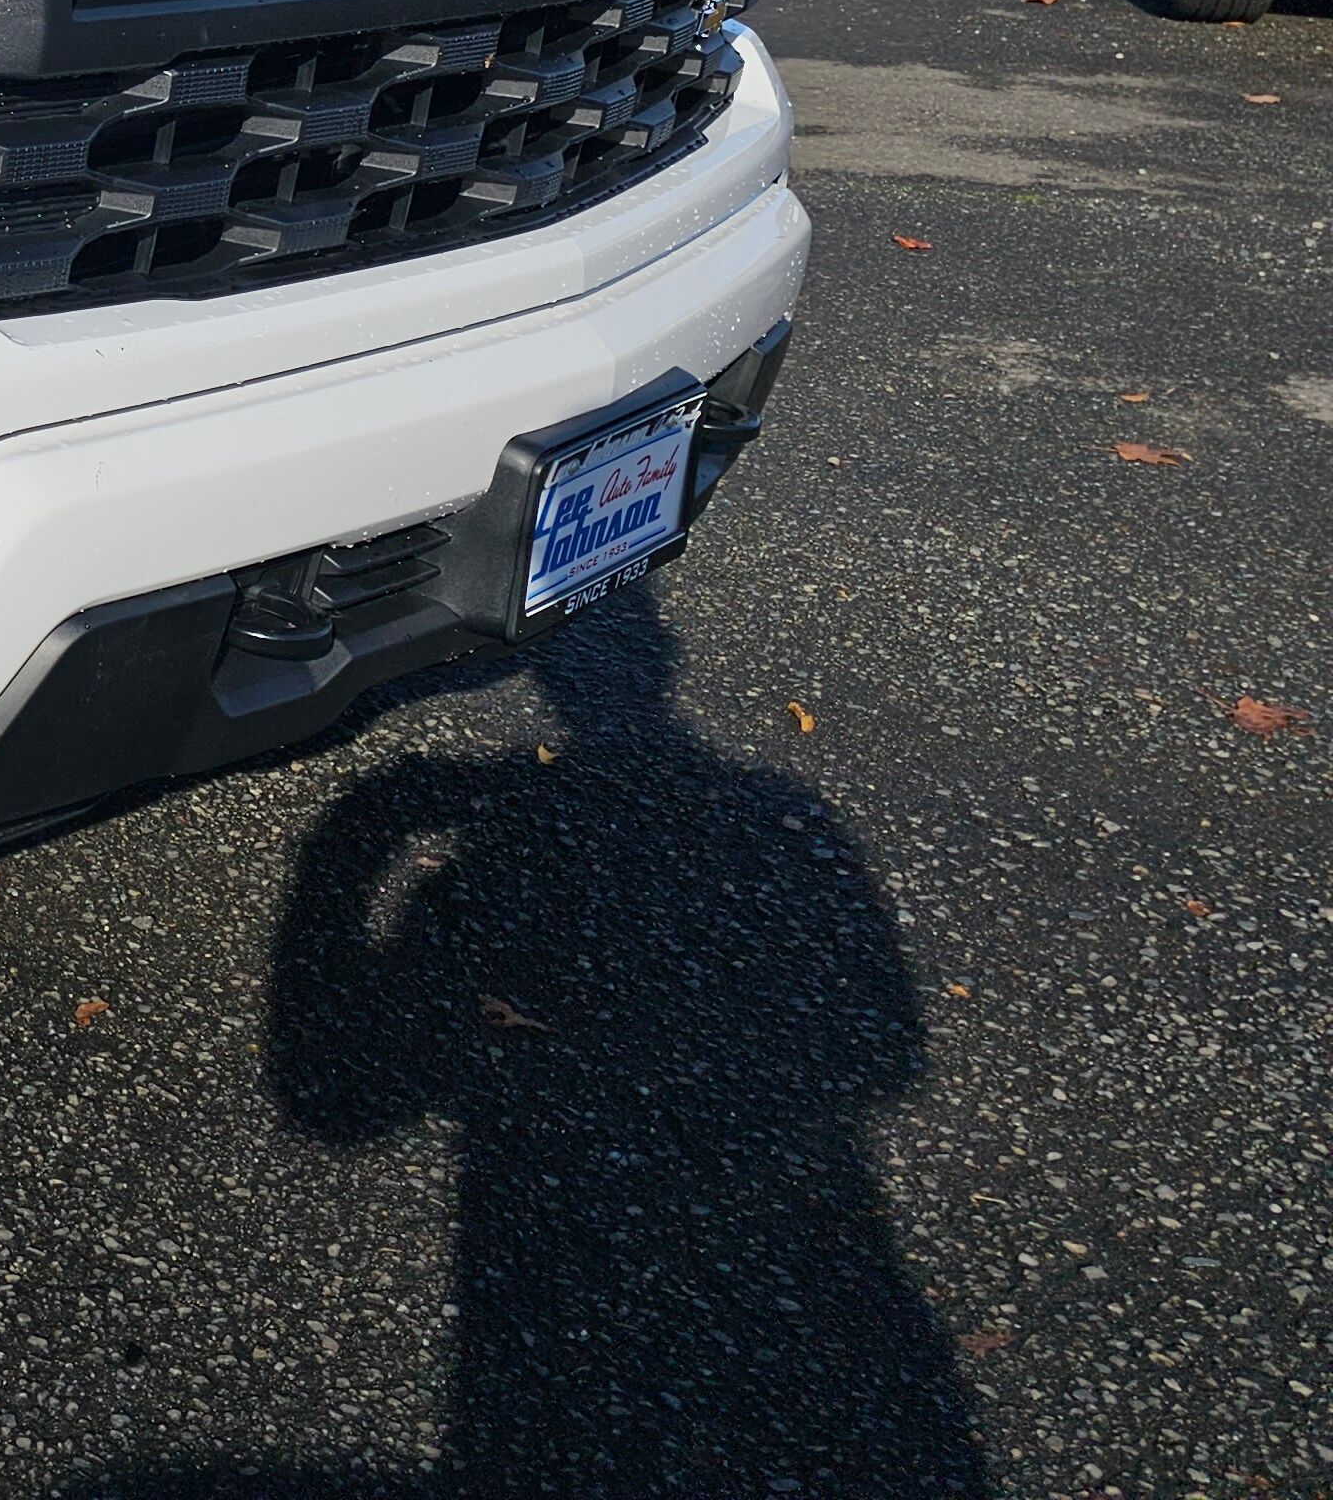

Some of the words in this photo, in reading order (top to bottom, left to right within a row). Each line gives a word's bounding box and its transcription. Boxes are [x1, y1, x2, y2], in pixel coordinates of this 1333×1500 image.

[599, 467, 632, 508] Auto
[634, 443, 679, 491] Family
[531, 491, 661, 582] Johnson
[533, 481, 594, 541] Lee
[564, 578, 611, 615] SINCE
[614, 557, 649, 589] 1933
[568, 554, 600, 578] SINCE
[603, 541, 628, 561] 1933
